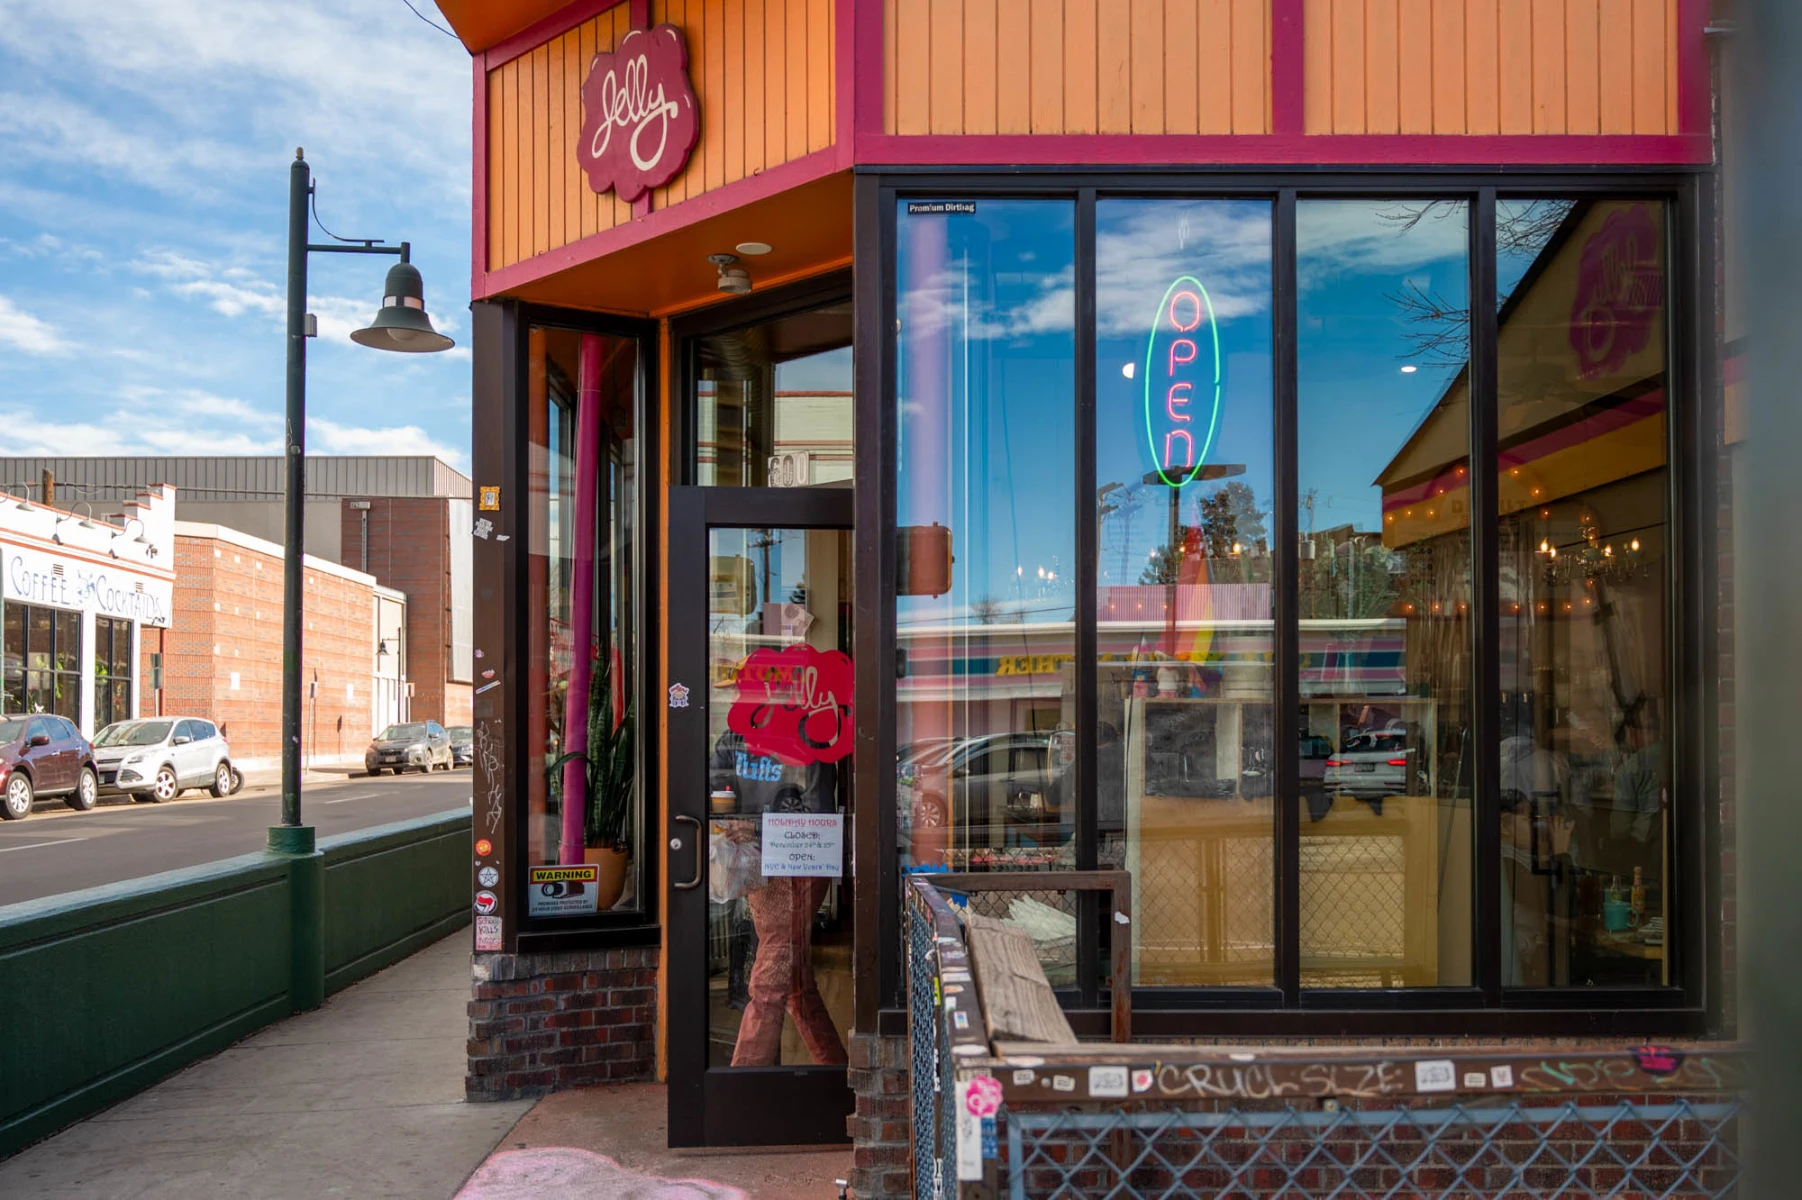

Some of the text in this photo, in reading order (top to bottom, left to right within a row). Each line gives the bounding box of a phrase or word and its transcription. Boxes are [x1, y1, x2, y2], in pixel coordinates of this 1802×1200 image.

[591, 54, 678, 171] Jelly
[945, 203, 975, 213] Dirtbag
[750, 665, 852, 749] Jelly
[735, 750, 783, 782] Tufts
[808, 818, 838, 828] HOURS
[536, 870, 592, 880] WARNING
